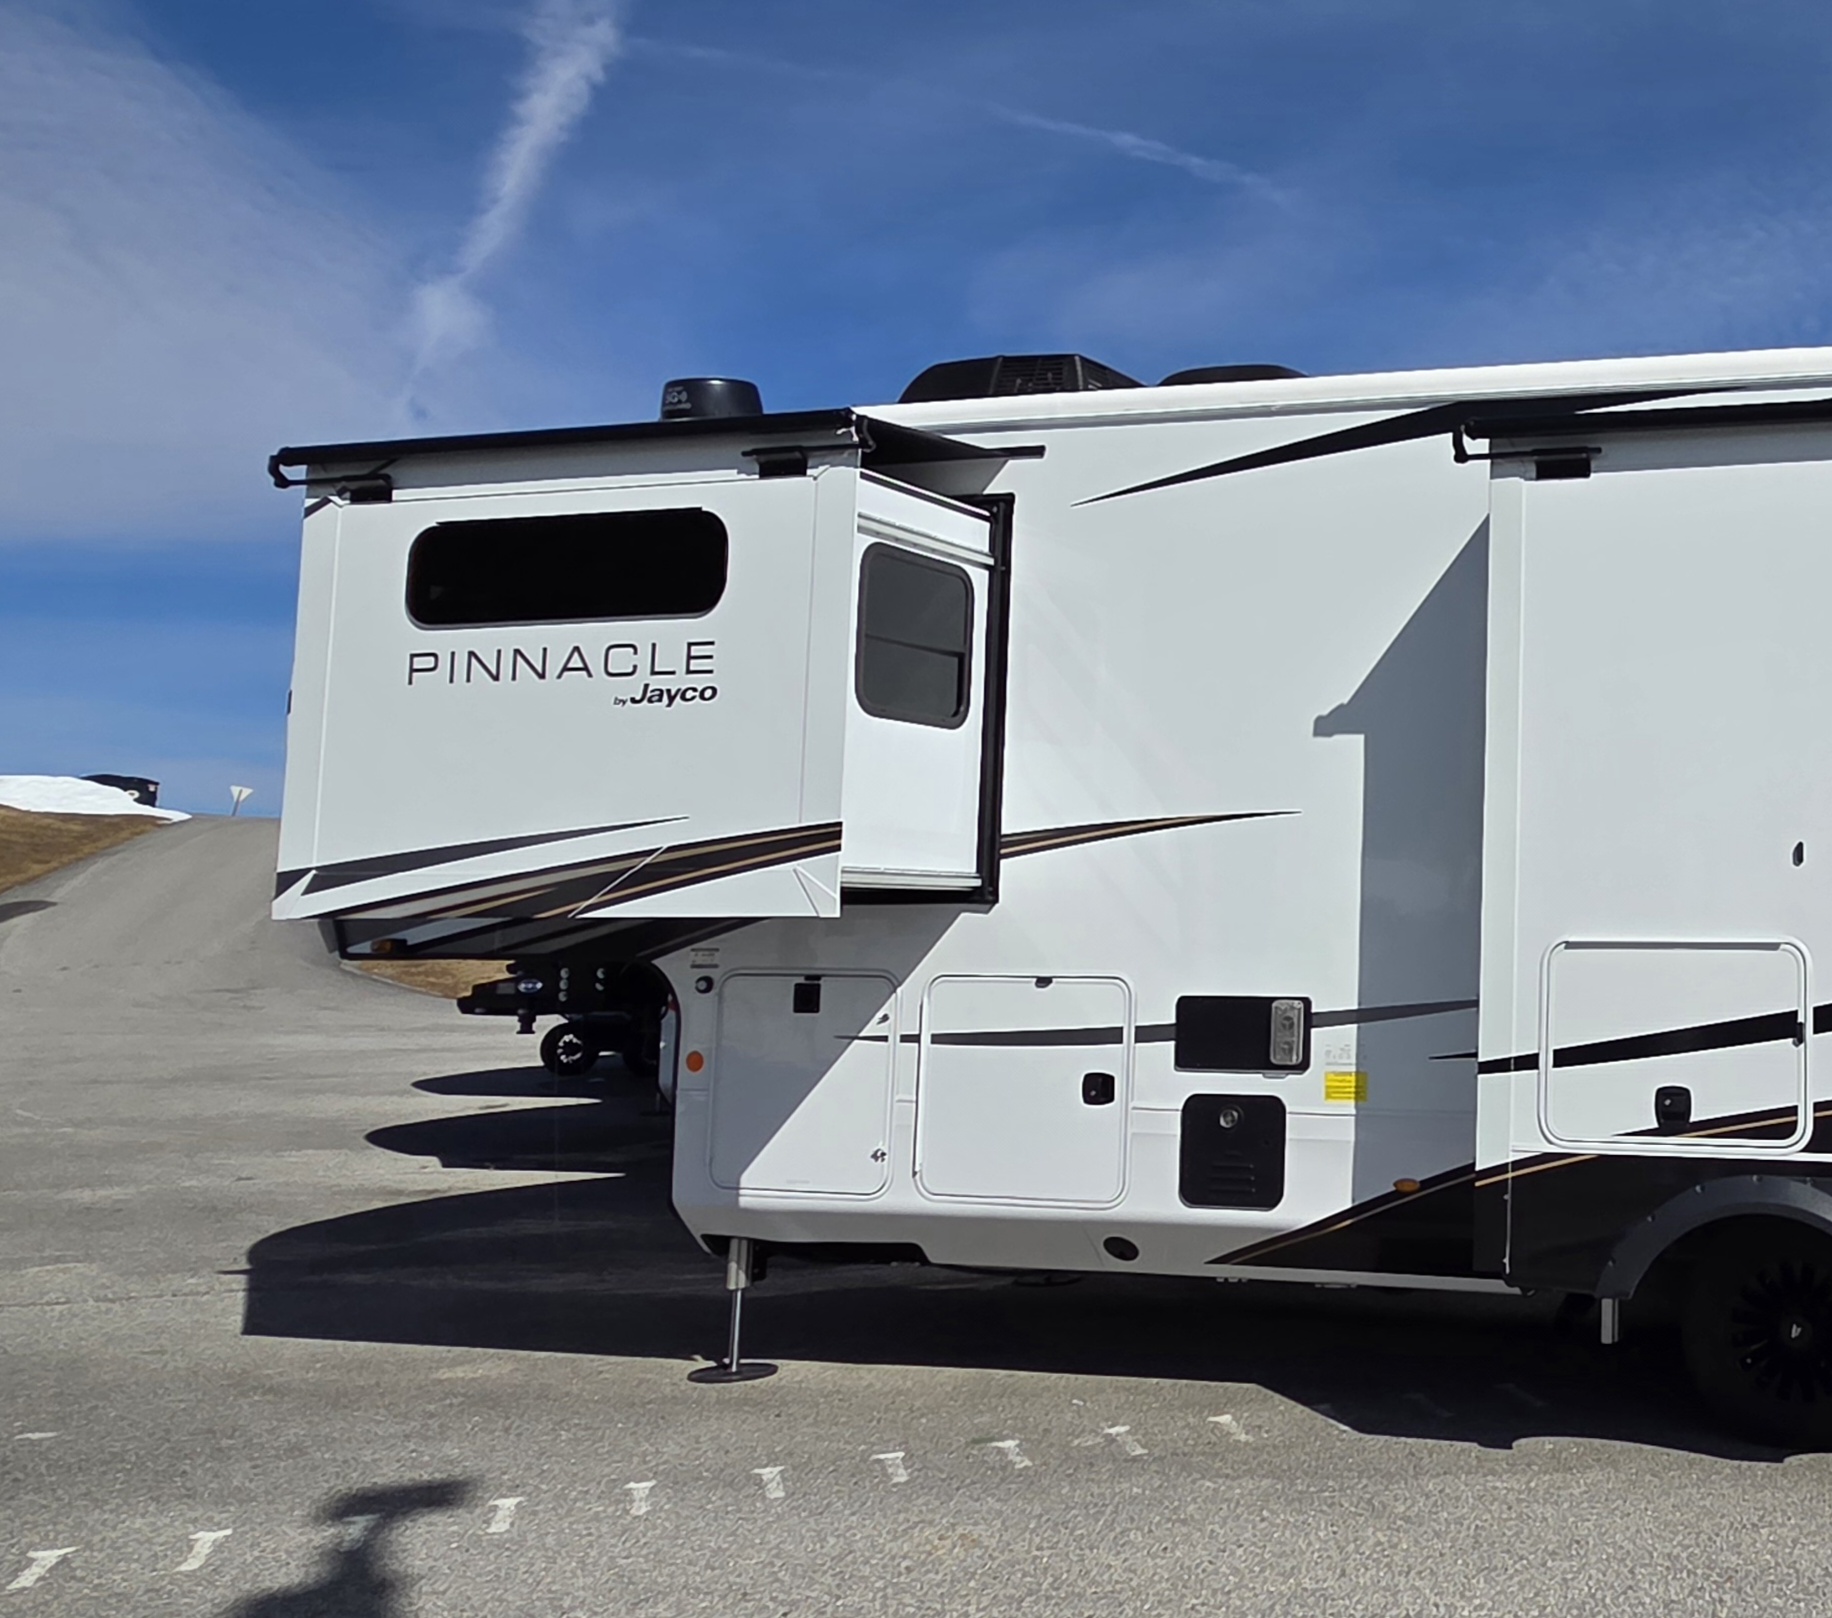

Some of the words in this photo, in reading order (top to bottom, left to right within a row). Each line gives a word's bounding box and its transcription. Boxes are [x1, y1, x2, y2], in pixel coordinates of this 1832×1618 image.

[408, 641, 716, 686] PINNACLE
[613, 696, 628, 707] by
[630, 683, 718, 708] Jayco
